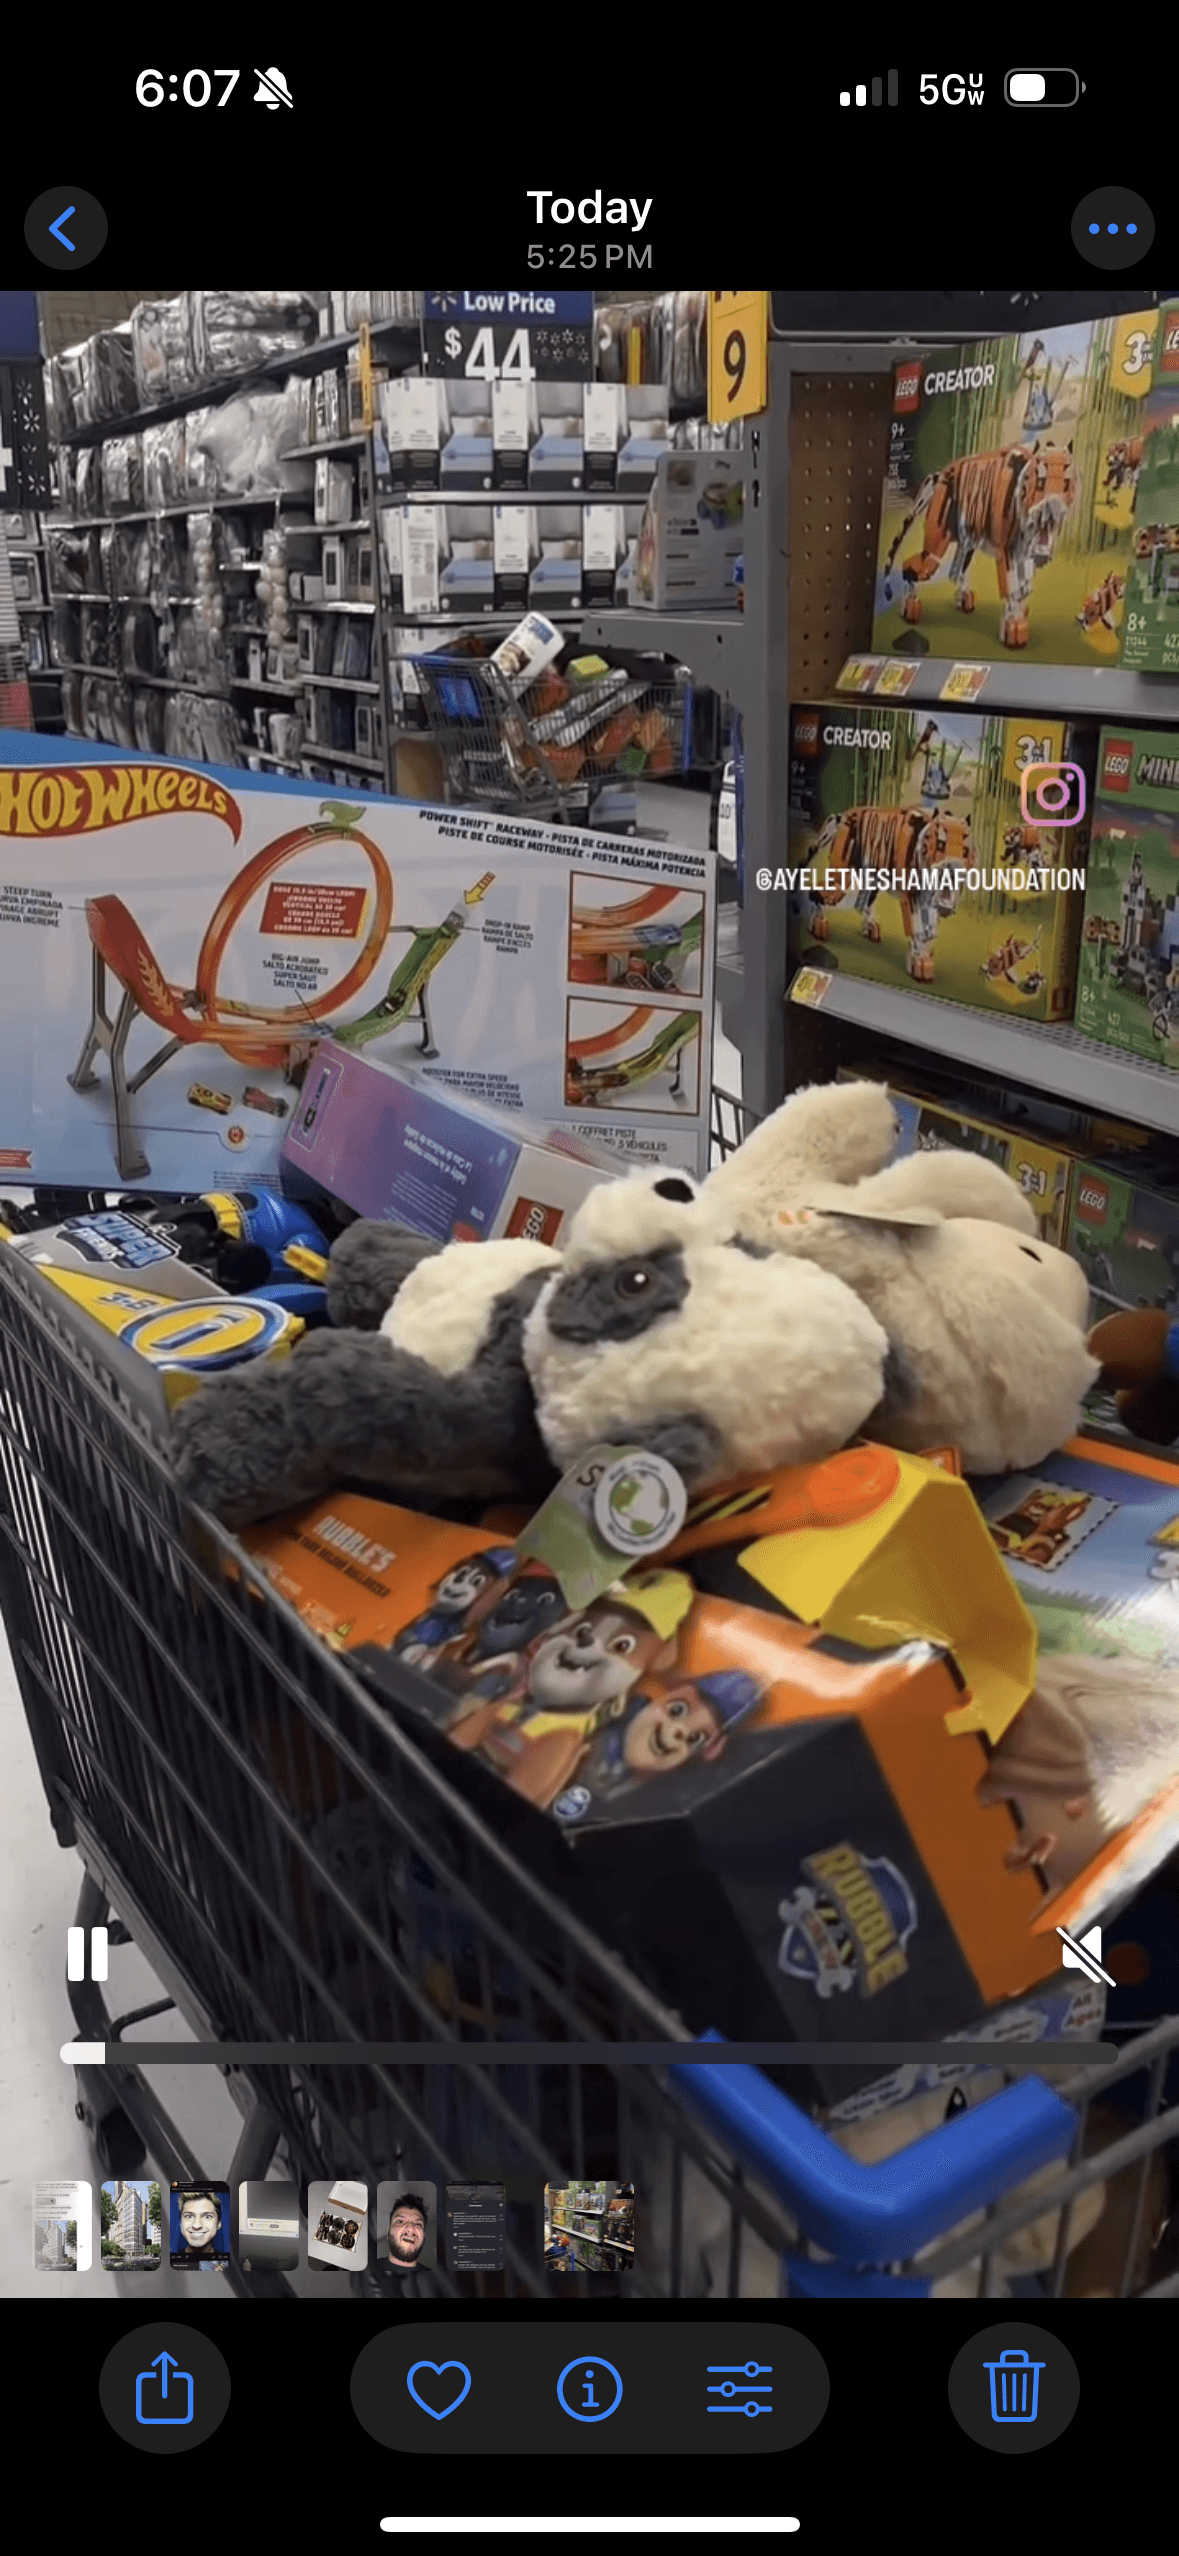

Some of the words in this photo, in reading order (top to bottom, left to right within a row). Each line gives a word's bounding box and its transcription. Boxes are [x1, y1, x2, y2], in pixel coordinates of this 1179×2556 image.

[464, 291, 505, 312] Low
[508, 291, 556, 314] Price
[724, 329, 746, 403] 9
[895, 376, 919, 396] LEGO
[924, 363, 995, 395] CREATOR
[891, 422, 906, 440] 9+
[1127, 612, 1147, 631] 8+
[823, 725, 892, 750] CREATOR
[1105, 756, 1129, 775] LEGO
[419, 809, 458, 825] POWER
[459, 817, 490, 830] SHIFT
[496, 823, 544, 839] RACEWAY
[552, 832, 580, 846] PISTA
[581, 837, 594, 848] DE
[596, 840, 645, 857] CARRERAS
[646, 848, 705, 866] MOTORIZADA
[438, 826, 468, 839] PISTE
[470, 831, 483, 841] DE
[486, 834, 525, 849] COURSE
[527, 840, 583, 858] MOTORISÉE
[592, 852, 618, 865] PISTA
[661, 863, 705, 878] POTENCIA
[0, 895, 19, 904] URVA
[3, 885, 29, 896] STEEP
[31, 888, 53, 899] TURN
[0, 904, 24, 913] IRAGE
[0, 913, 21, 923] URVA
[1081, 985, 1095, 1002] 8+
[1080, 1188, 1105, 1210] LEGO
[521, 1205, 546, 1240] EGO
[313, 1515, 397, 1574] RUBBLE'S
[810, 1846, 907, 1993] RUBBLE
